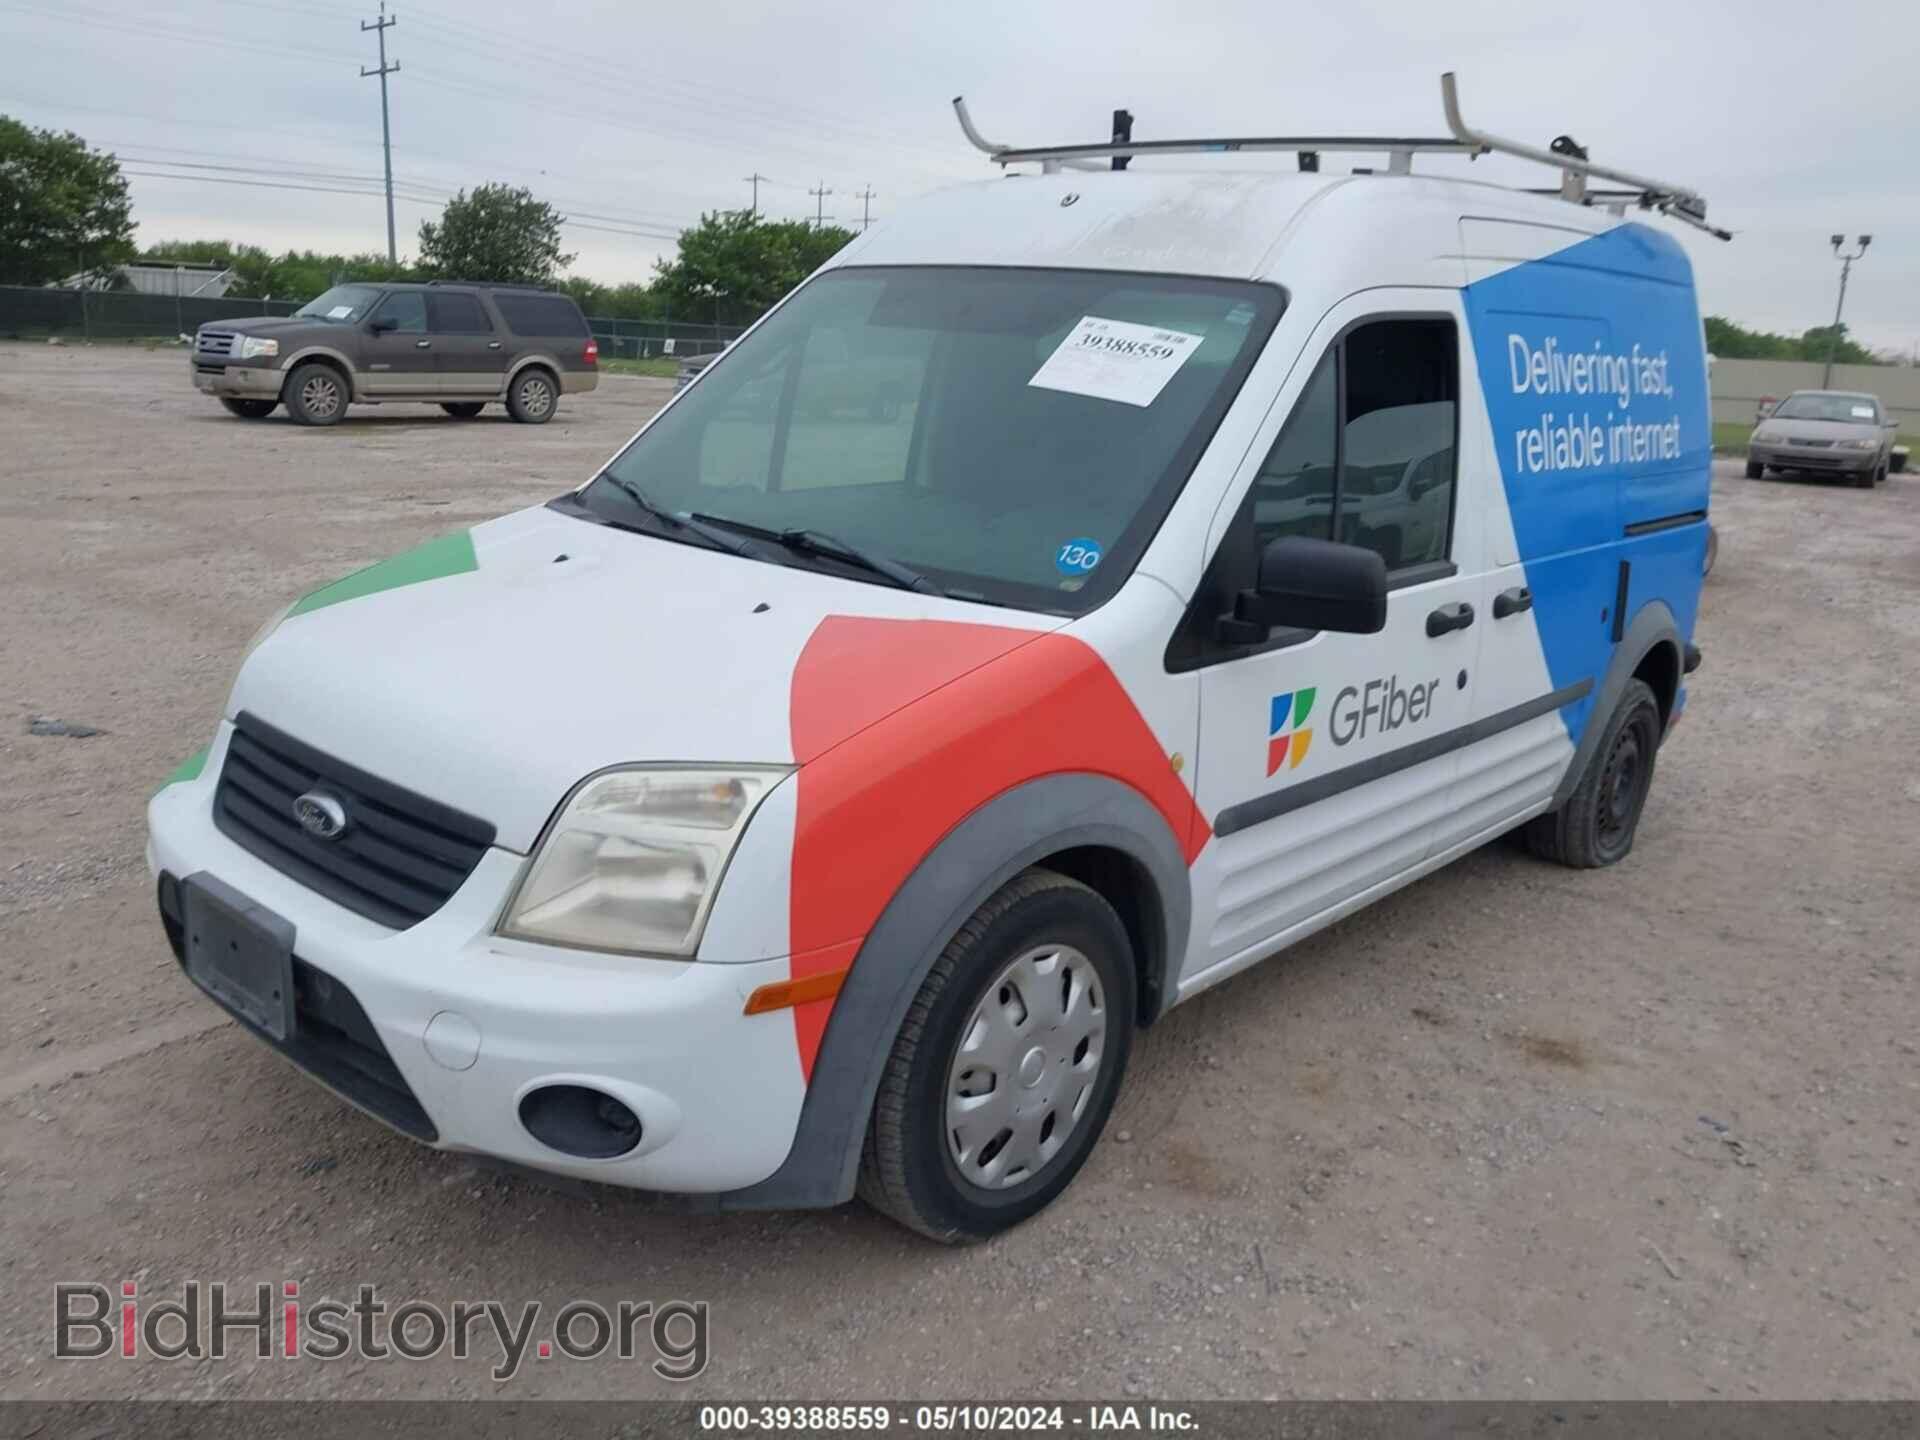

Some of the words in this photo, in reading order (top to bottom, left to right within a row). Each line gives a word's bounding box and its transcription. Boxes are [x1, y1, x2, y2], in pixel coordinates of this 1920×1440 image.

[1508, 333, 1631, 409] Delivering
[1631, 343, 1673, 400] fast,
[1516, 412, 1604, 473] reliable
[1607, 411, 1680, 463] internet
[1060, 545, 1099, 569] 130
[1329, 675, 1440, 746] GFiber
